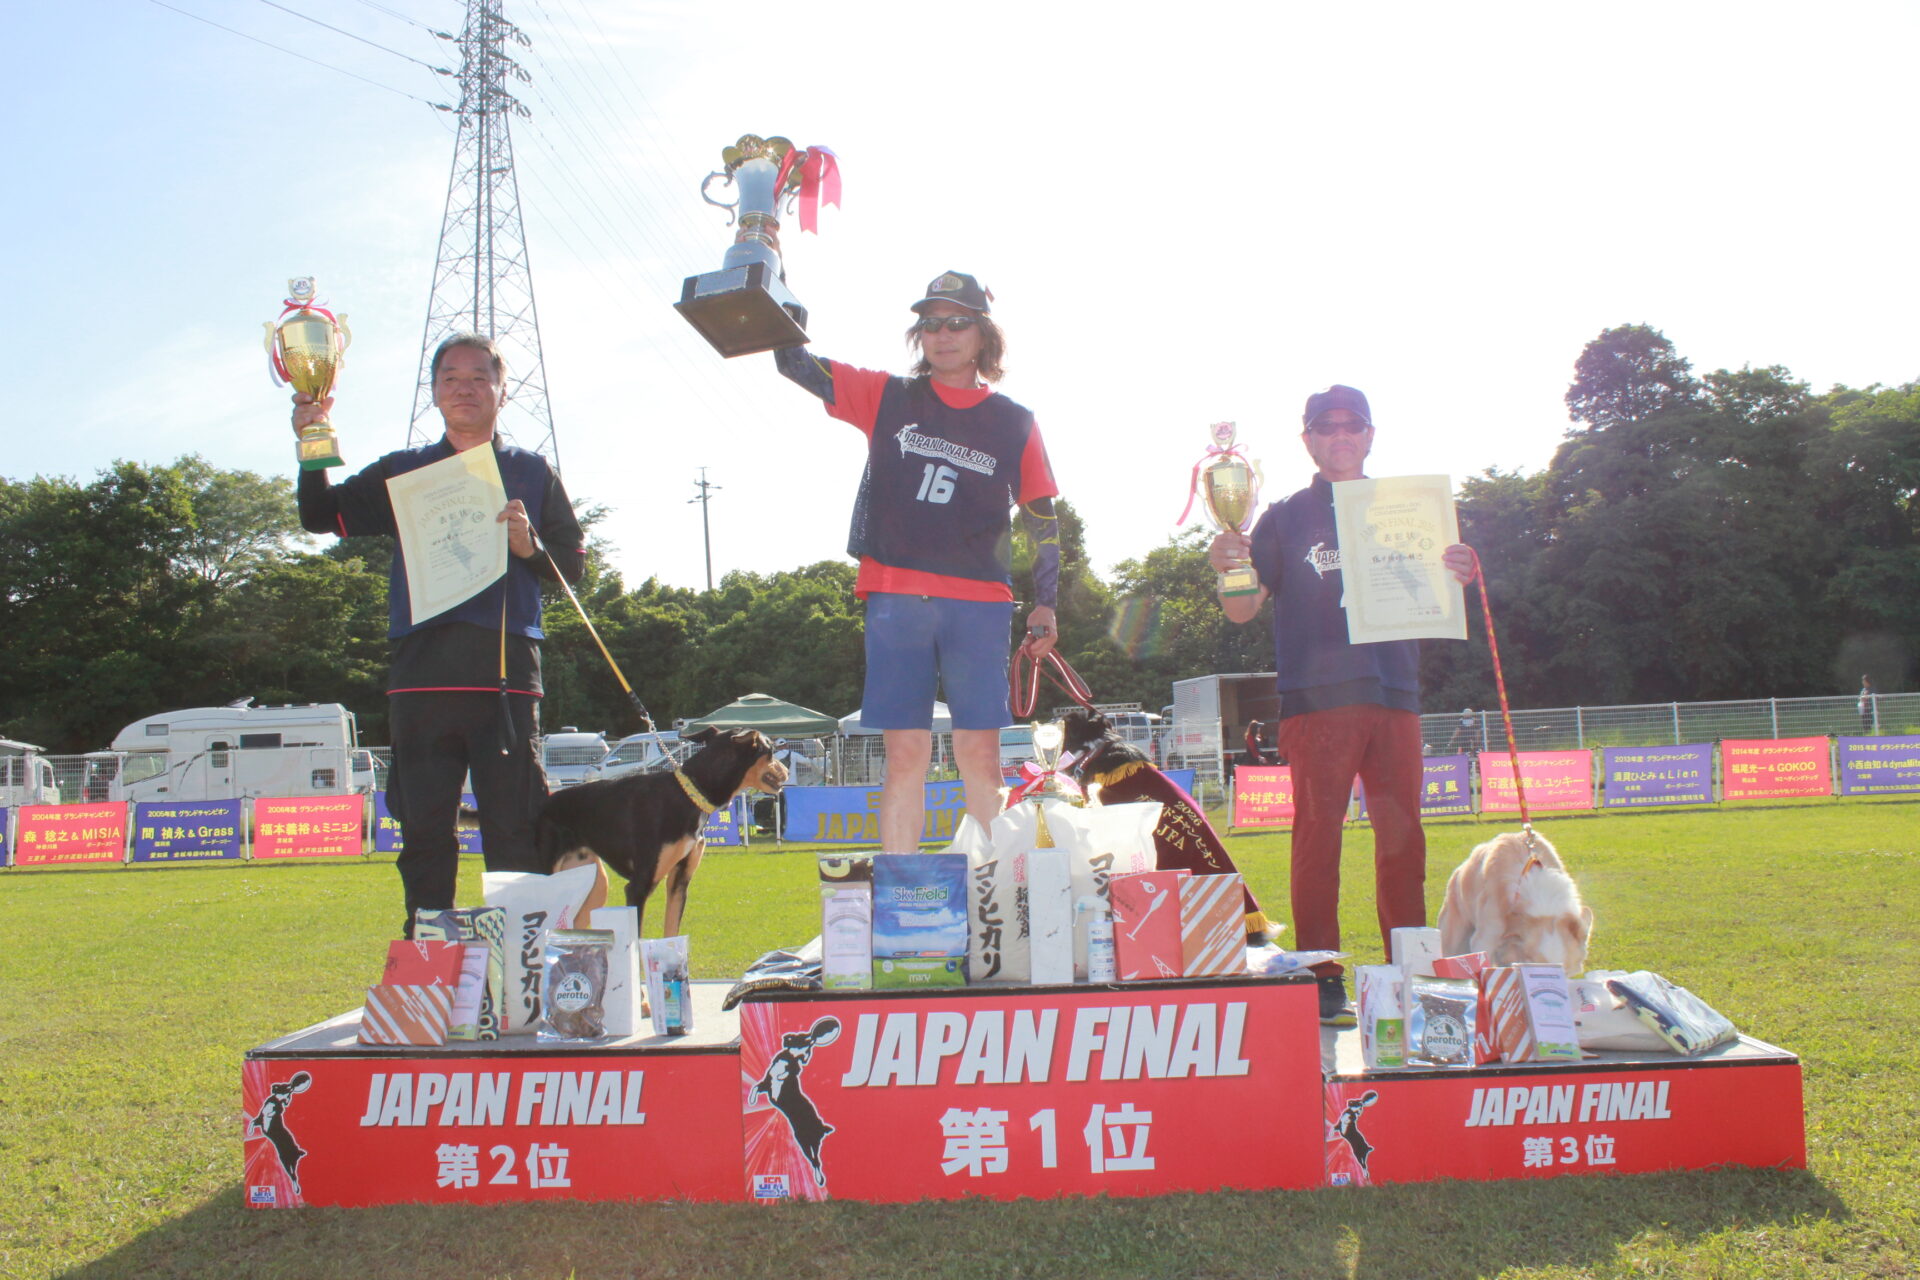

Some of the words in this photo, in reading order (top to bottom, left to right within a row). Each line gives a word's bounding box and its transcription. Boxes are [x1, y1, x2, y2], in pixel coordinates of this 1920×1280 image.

[904, 432, 940, 450] JAPAN
[939, 439, 969, 460] FINAL
[969, 450, 997, 468] 2026
[916, 463, 958, 504] 16
[1424, 764, 1456, 772] チャンピオン
[1776, 761, 1816, 773] GOKOO
[815, 812, 880, 840] JAPA
[1175, 801, 1202, 826] 2026
[82, 826, 120, 840] MISIA
[198, 826, 234, 838] Grass
[1156, 824, 1184, 850] JFA
[894, 886, 948, 901] SkyField
[974, 860, 1004, 979] コシヒカリ
[520, 911, 548, 1026] コシヒカリ
[556, 992, 588, 1000] perotto
[841, 1008, 1058, 1088] JAPAN
[1065, 1002, 1250, 1082] FINAL
[1426, 1036, 1462, 1046] perotto
[360, 1072, 511, 1127] JAPAN
[515, 1070, 646, 1126] FINAL
[1465, 1084, 1576, 1127] JAPAN
[1578, 1081, 1671, 1123] FINAL
[938, 1103, 1155, 1176] 第1位
[1523, 1135, 1616, 1168] 第3位
[435, 1143, 572, 1190] 第2位
